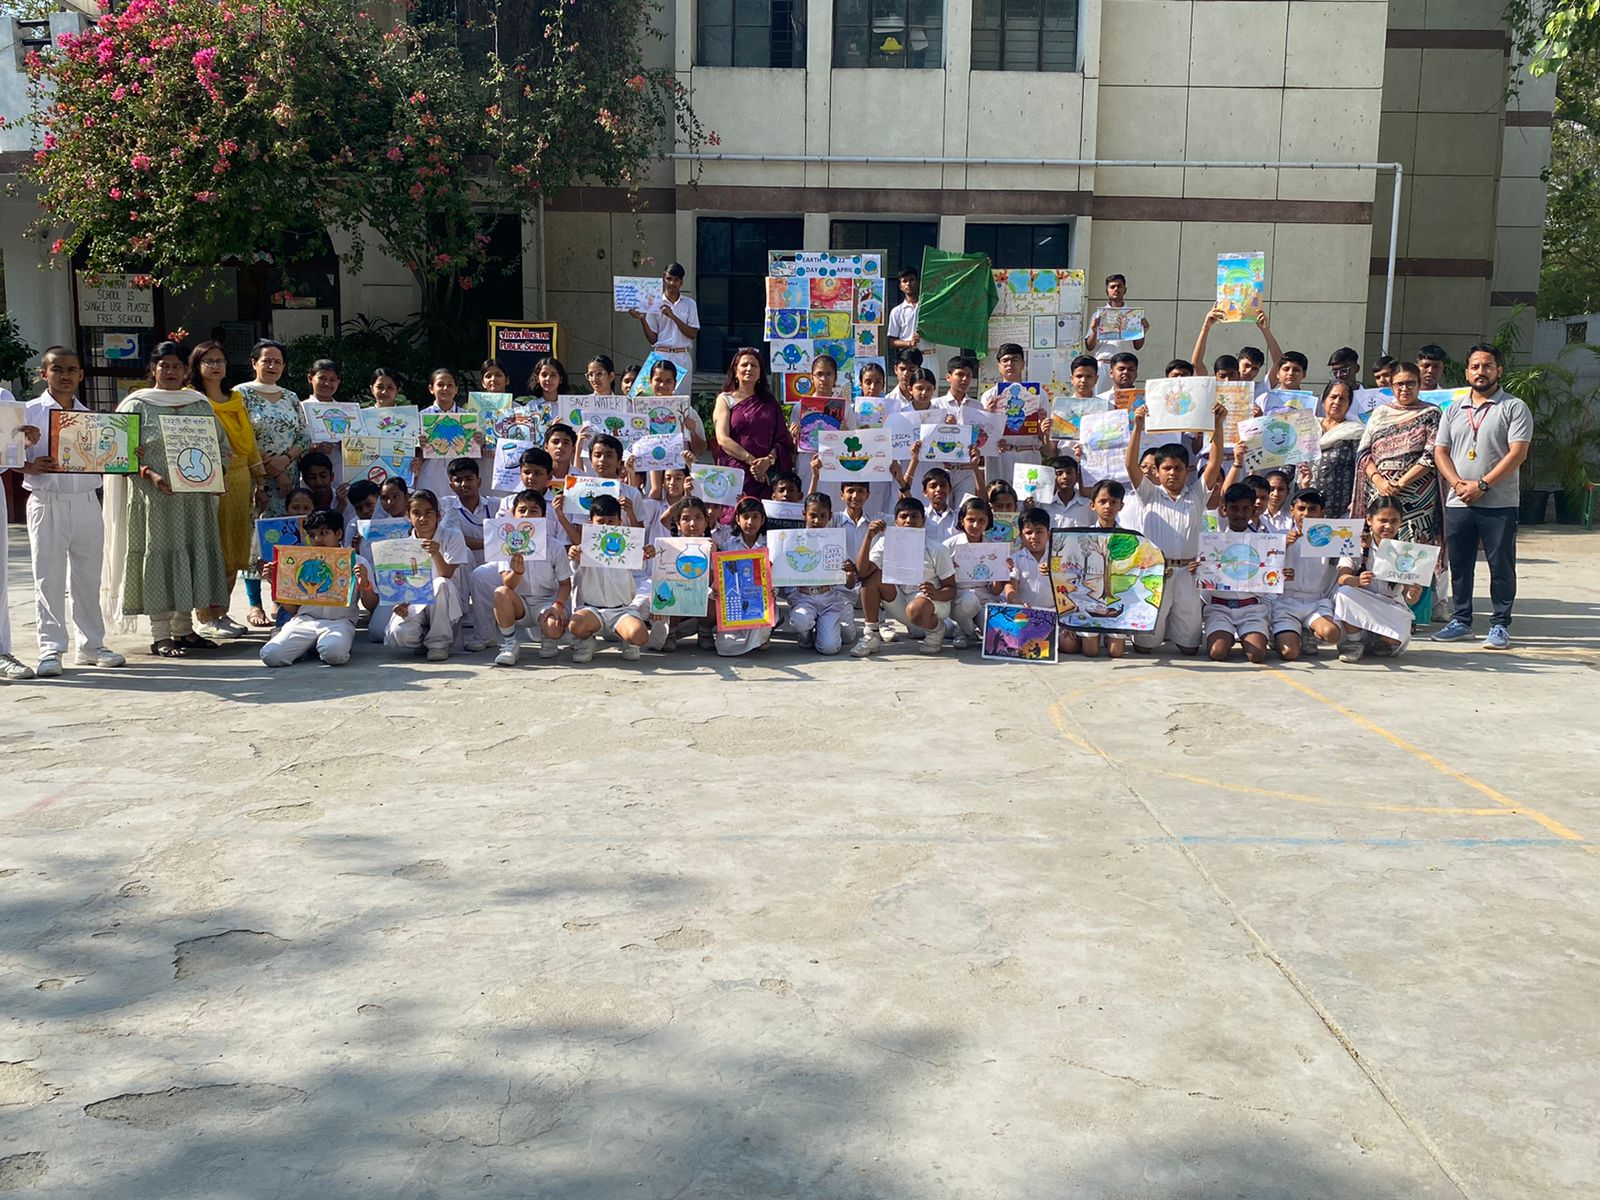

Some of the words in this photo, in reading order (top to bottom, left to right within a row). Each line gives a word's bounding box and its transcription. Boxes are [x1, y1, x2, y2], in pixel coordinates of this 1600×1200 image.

[97, 289, 120, 300] SCHOOL
[127, 291, 135, 301] IS
[84, 301, 105, 312] SINGLE
[110, 301, 122, 312] USE
[127, 302, 151, 313] PLASTIC
[97, 313, 113, 324] FREE
[117, 314, 144, 324] SCHOOL
[500, 329, 521, 339] VIDYA
[500, 340, 522, 351] PUBLIC
[525, 341, 548, 352] SCHOOL
[569, 397, 590, 407] SAVE
[594, 396, 621, 410] WATER
[891, 440, 911, 448] WASTE
